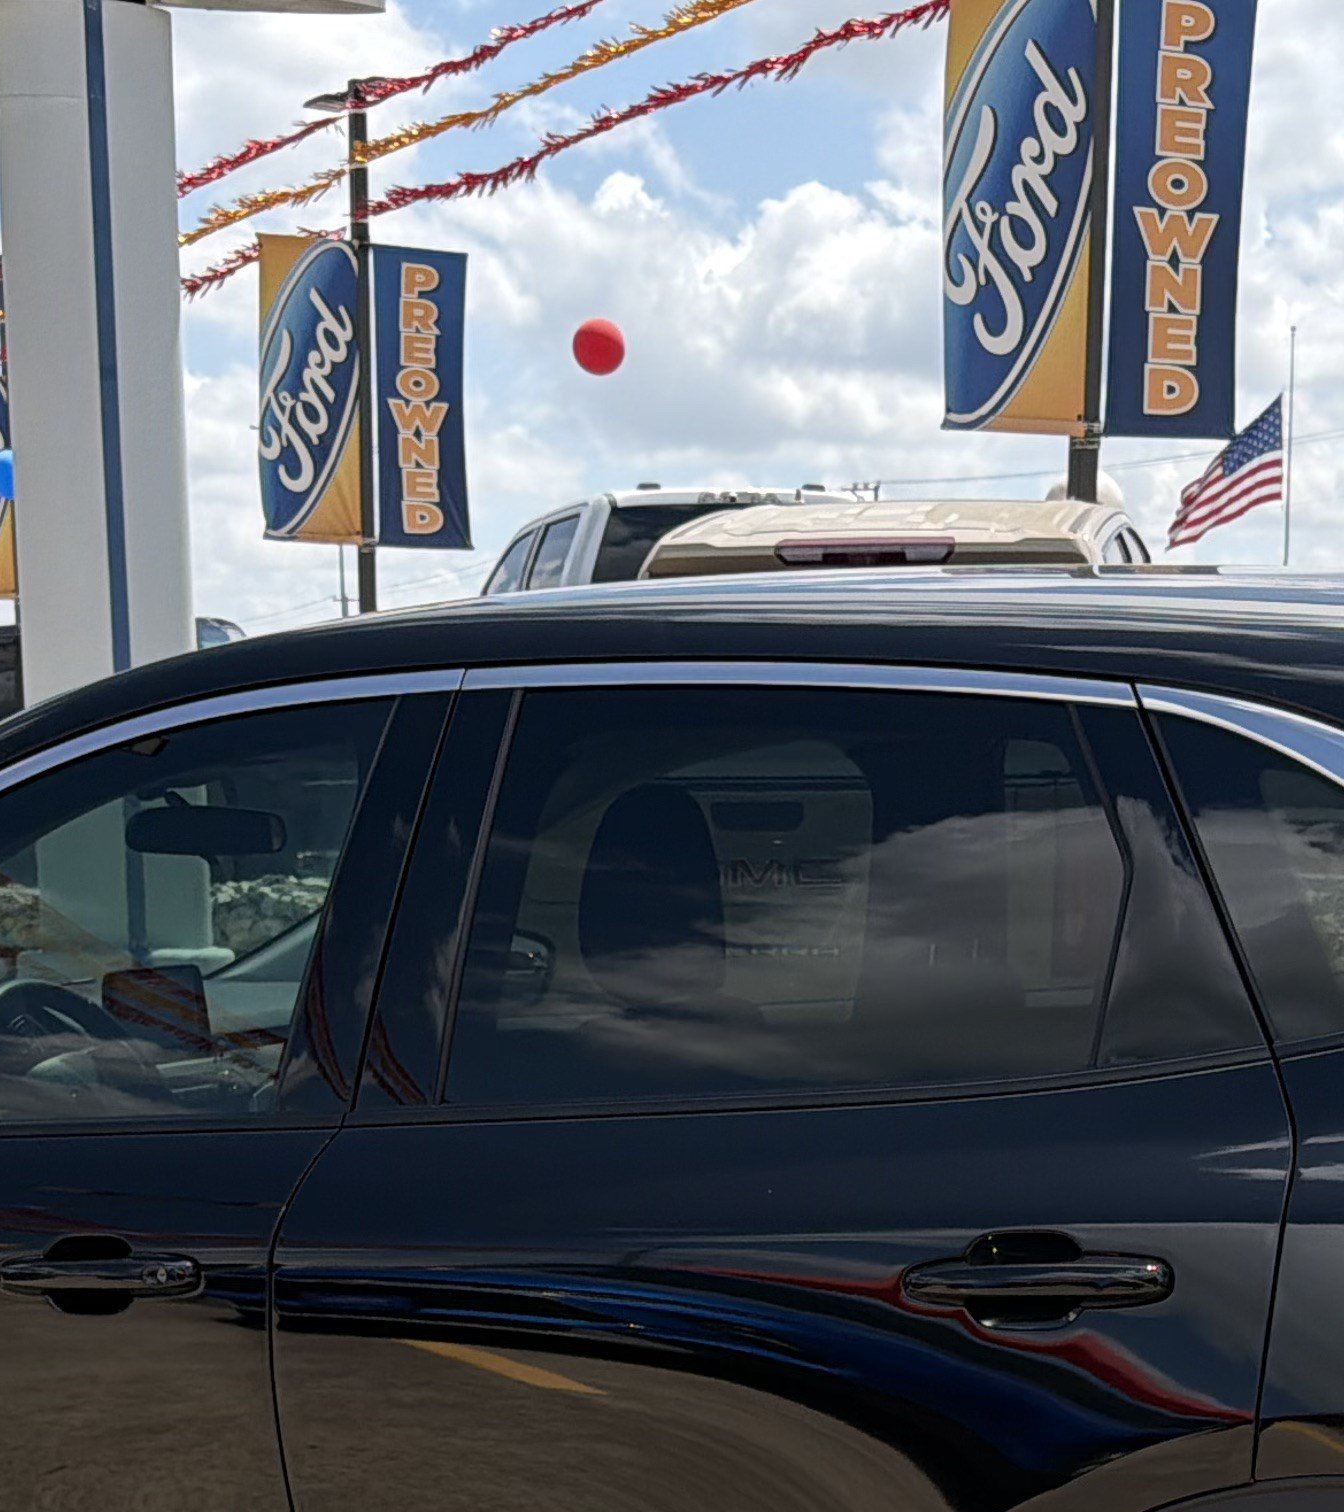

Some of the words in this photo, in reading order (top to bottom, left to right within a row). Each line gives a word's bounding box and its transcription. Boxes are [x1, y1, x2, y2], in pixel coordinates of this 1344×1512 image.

[943, 37, 1087, 356] Ford
[1132, 0, 1220, 416] PREOWNED
[258, 287, 355, 493] Ford
[386, 261, 450, 535] PREOWNED
